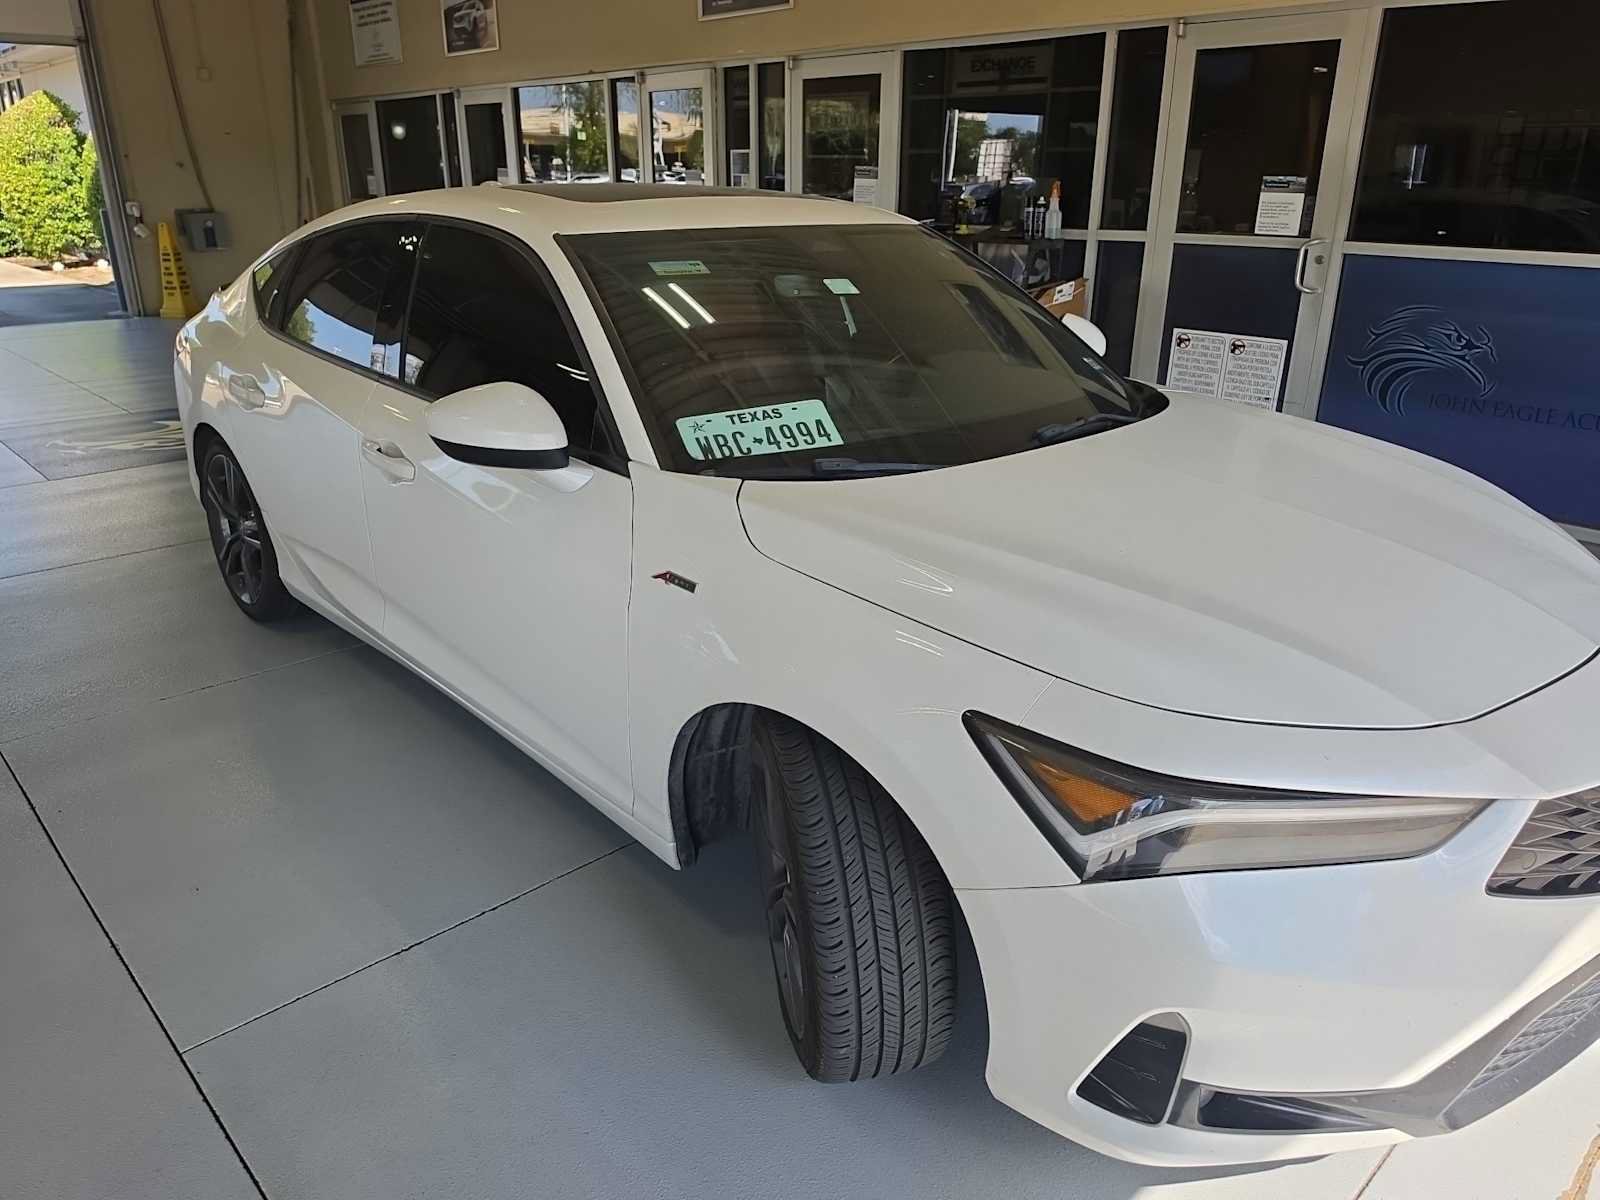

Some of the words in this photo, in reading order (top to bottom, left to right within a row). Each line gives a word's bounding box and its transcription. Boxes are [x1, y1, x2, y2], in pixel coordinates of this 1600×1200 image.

[725, 407, 784, 426] TEXAS
[1426, 391, 1486, 415] JOHN
[1493, 400, 1560, 425] EAGLE
